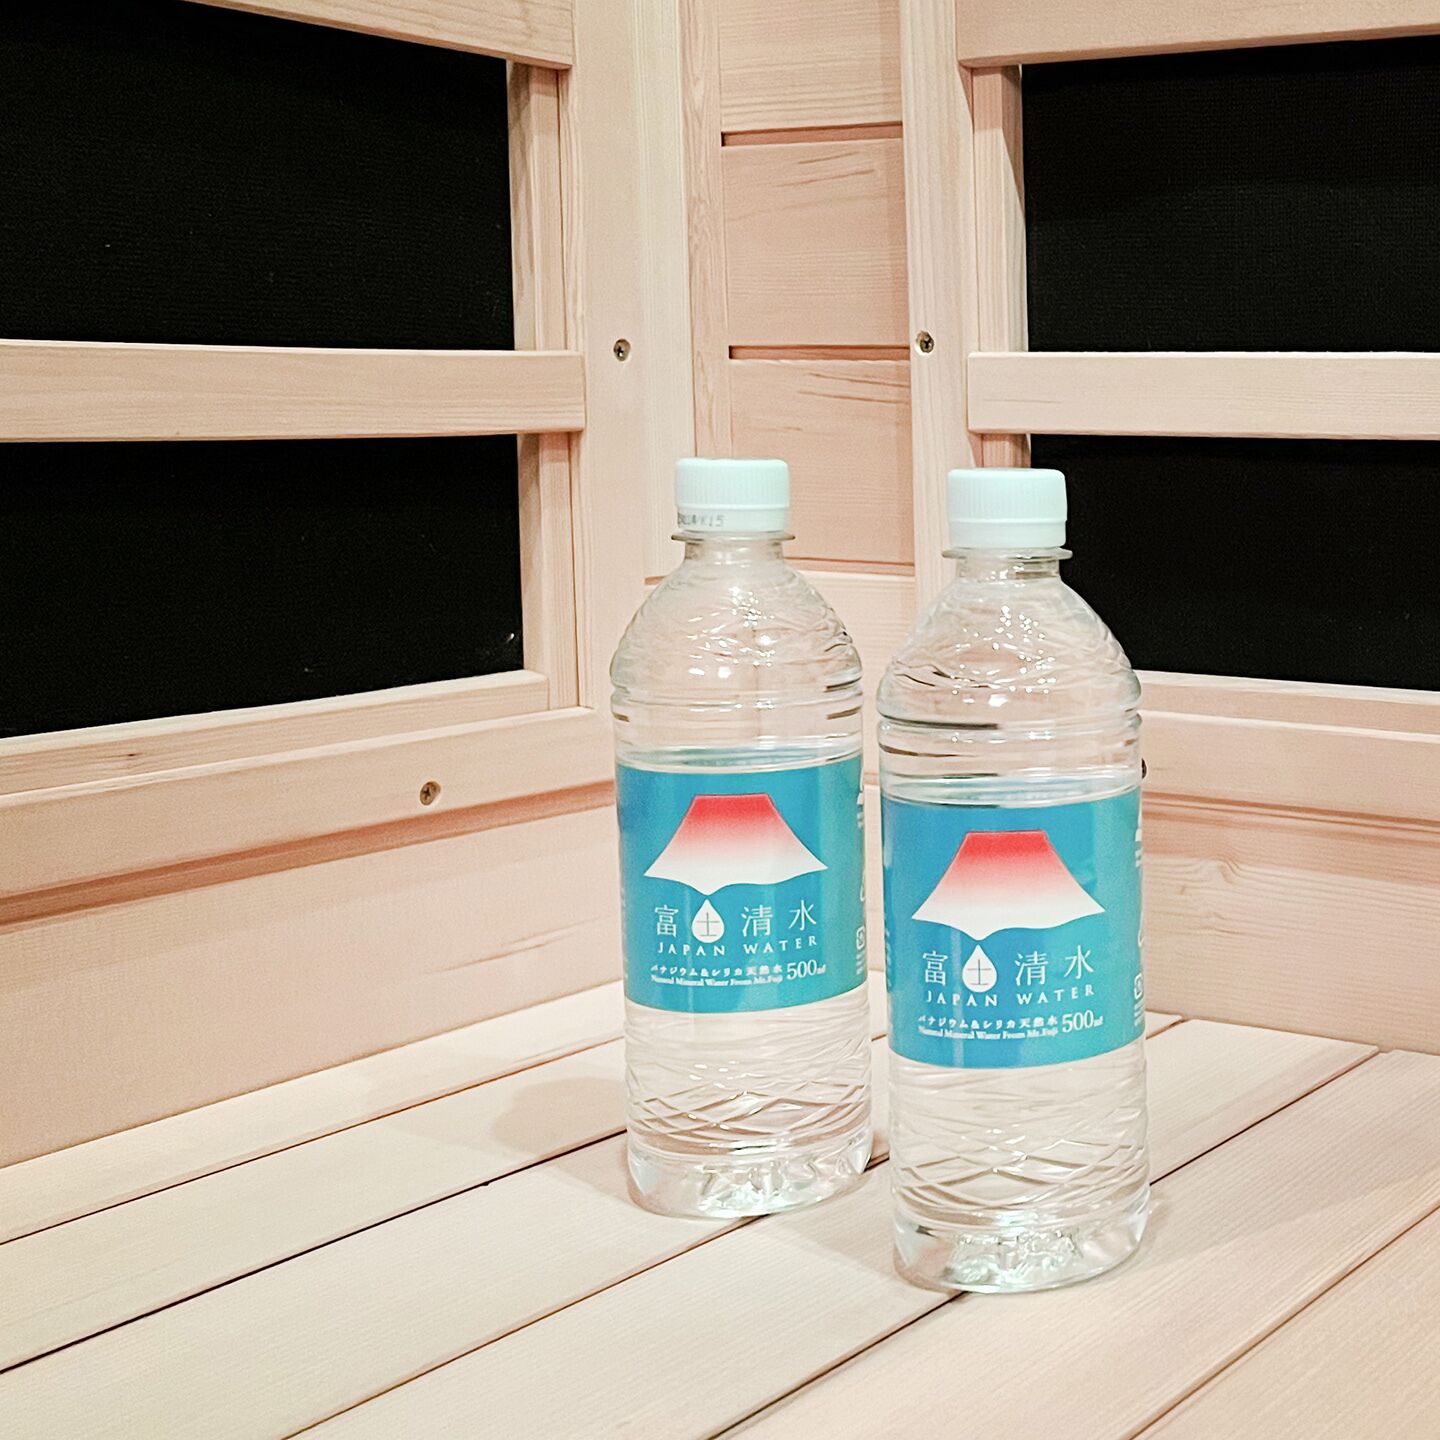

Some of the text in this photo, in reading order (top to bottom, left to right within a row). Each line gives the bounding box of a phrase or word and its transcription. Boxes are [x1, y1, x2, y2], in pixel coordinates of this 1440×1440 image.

[654, 899, 818, 938] 富士清水
[658, 935, 818, 957] JAPAN WATER
[922, 944, 1094, 987] 富士清水
[926, 983, 1095, 1007] JAPAN WATER
